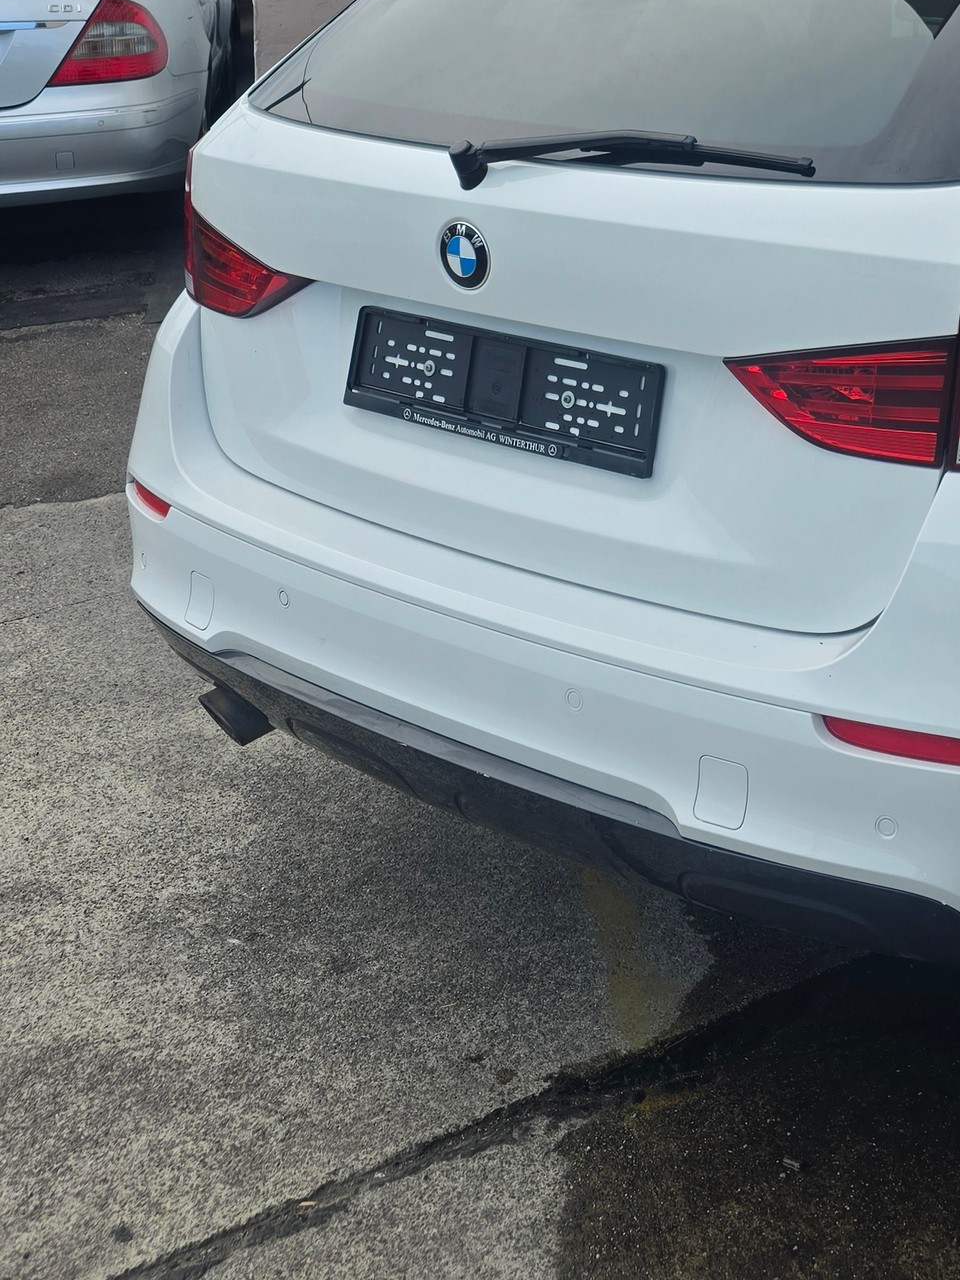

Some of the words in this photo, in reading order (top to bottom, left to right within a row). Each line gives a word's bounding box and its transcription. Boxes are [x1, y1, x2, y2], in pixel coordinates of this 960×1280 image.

[48, 4, 81, 13] CDI
[443, 224, 484, 244] BMW
[413, 412, 455, 431] Mercedes-Benz
[455, 425, 486, 439] Automobil
[486, 433, 497, 442] AG
[499, 434, 546, 454] WINTERTHUR
